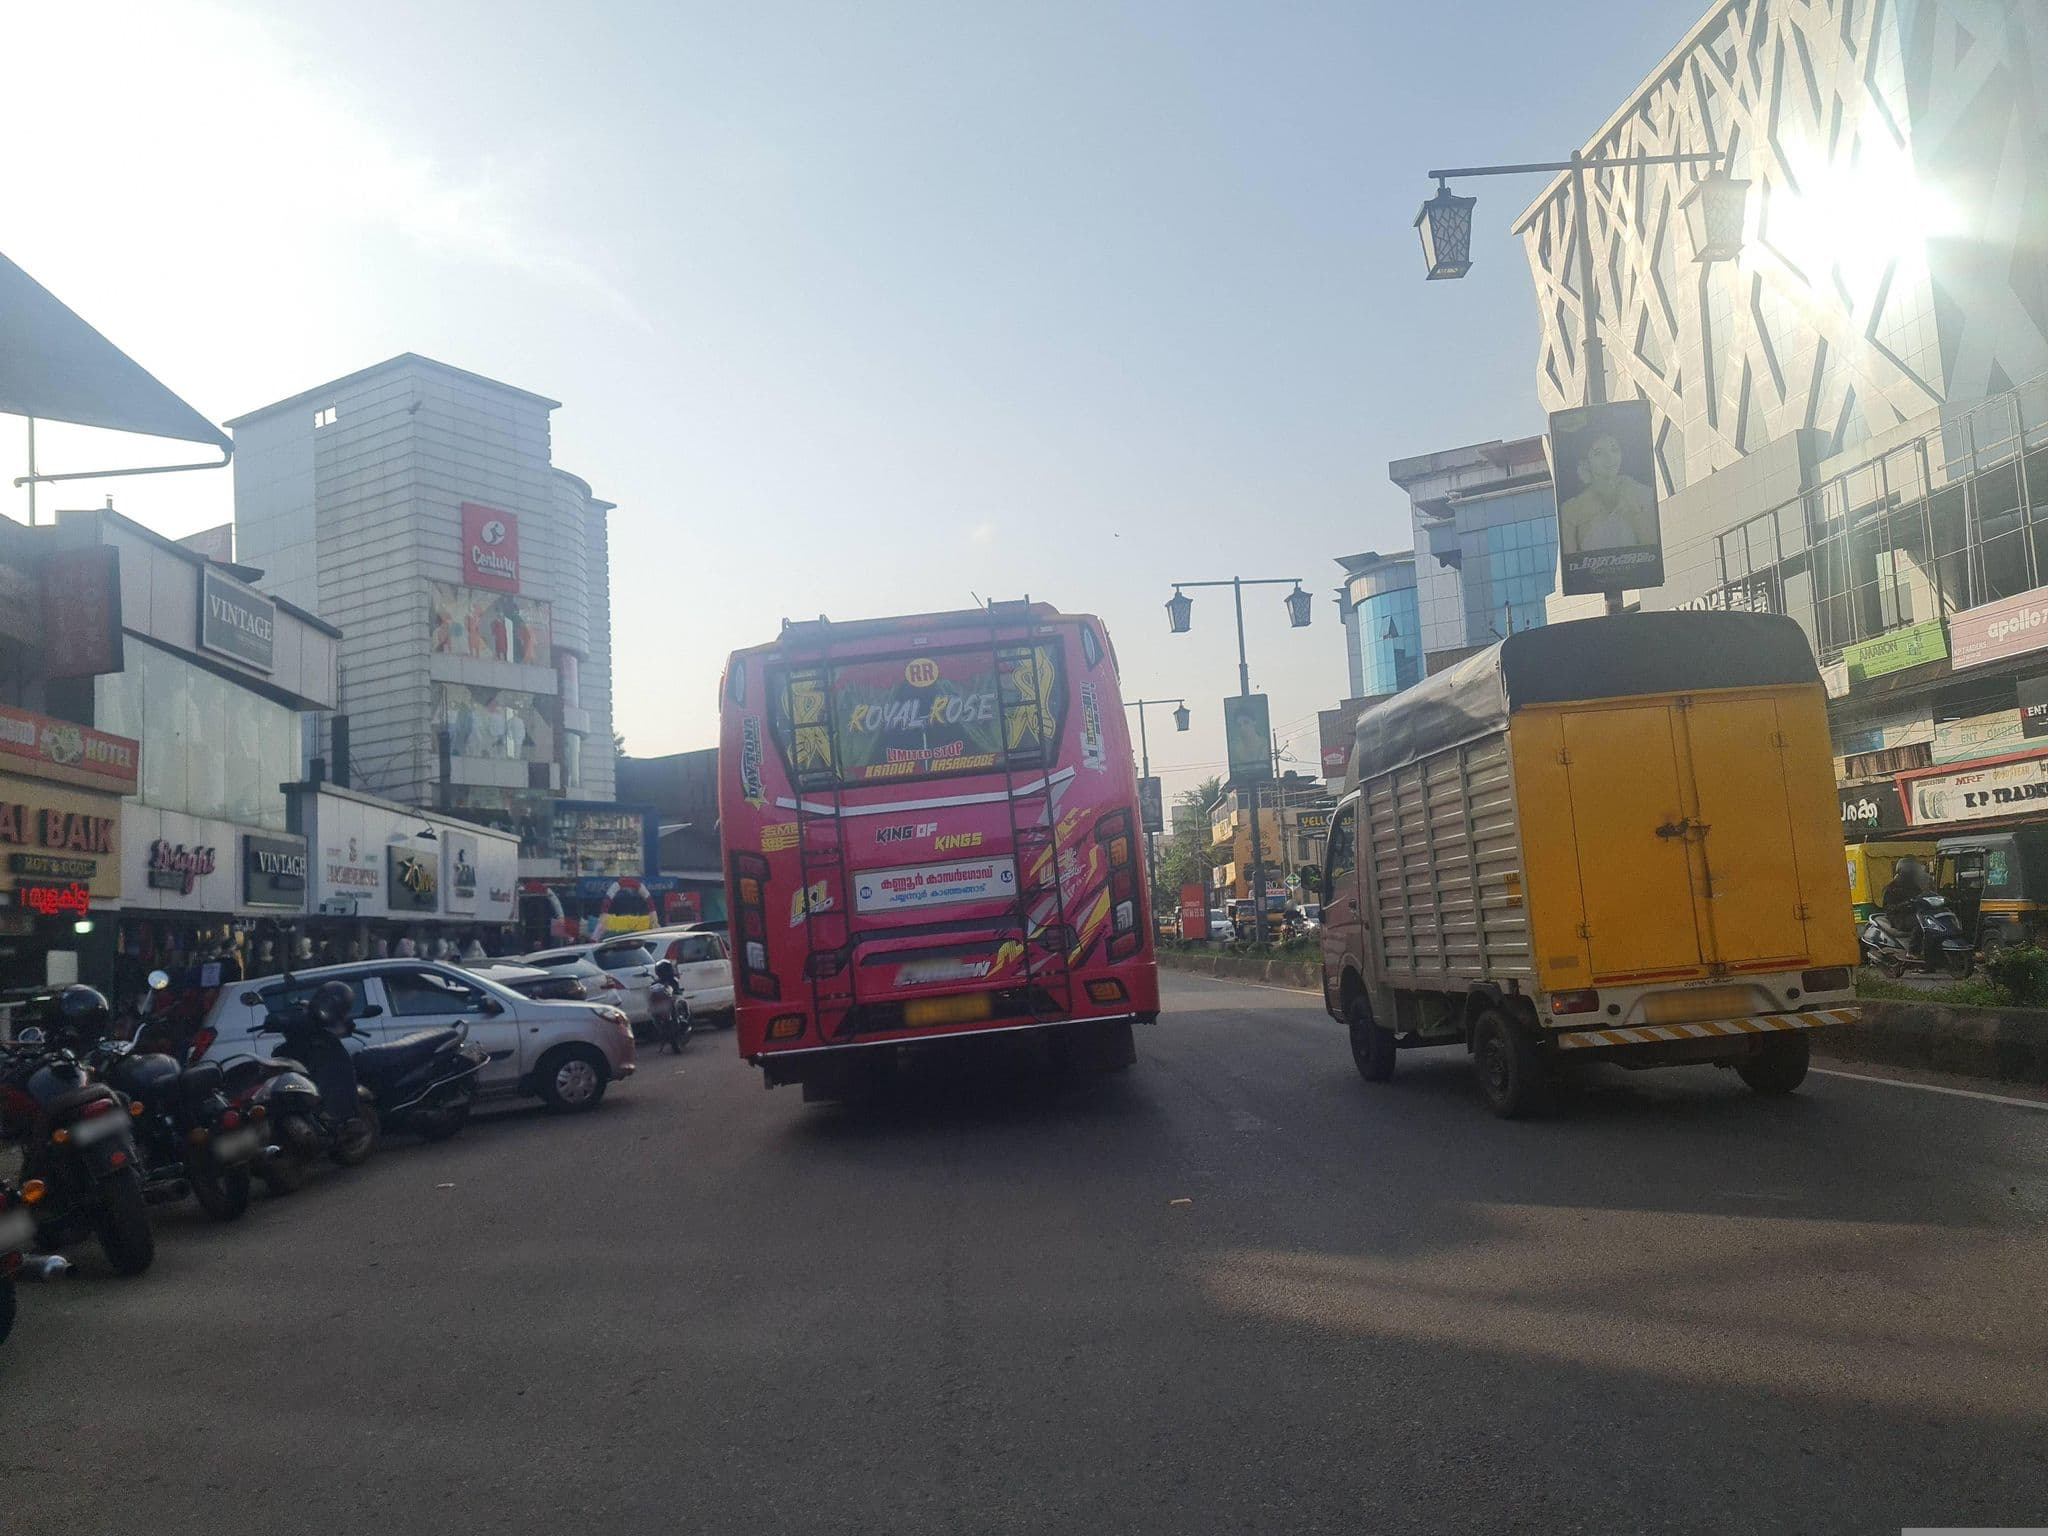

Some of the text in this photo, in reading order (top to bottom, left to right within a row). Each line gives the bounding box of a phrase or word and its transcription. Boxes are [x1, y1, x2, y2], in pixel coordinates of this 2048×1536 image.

[472, 545, 517, 579] Century
[210, 594, 272, 641] VINTAGE
[1987, 607, 2041, 642] apollo
[1858, 640, 1898, 662] AMARON
[908, 663, 934, 683] RR
[849, 693, 998, 733] ROYAL ROSE
[886, 740, 963, 763] LIMITED STOP
[930, 753, 996, 772] KASARGODE
[1955, 773, 1985, 786] MRF
[1992, 781, 2048, 805] TRADE
[43, 808, 114, 853] BAIK
[876, 822, 938, 844] KING OF
[935, 832, 982, 851] KINGS
[259, 851, 305, 876] VINTAGE
